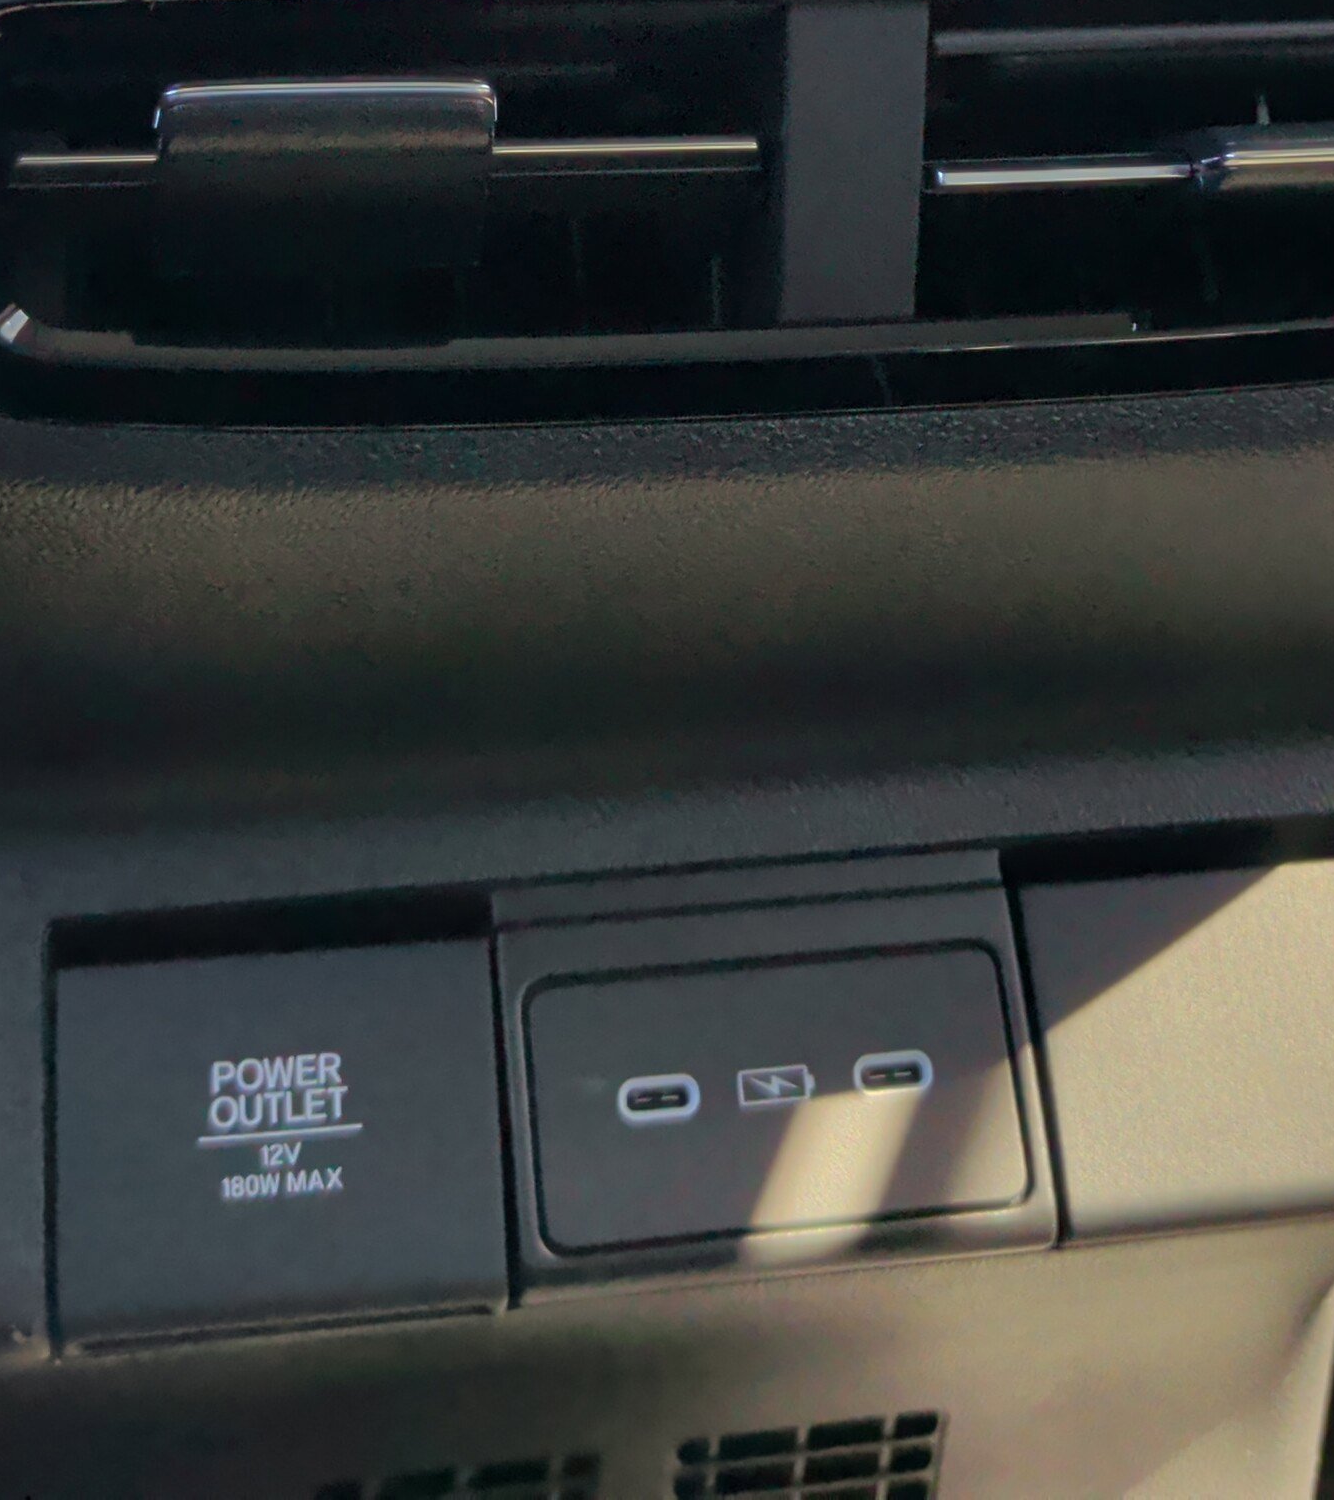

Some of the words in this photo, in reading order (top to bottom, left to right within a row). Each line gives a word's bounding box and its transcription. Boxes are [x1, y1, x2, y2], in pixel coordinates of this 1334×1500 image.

[210, 1052, 342, 1094] POWER
[210, 1086, 348, 1128] OUTLET
[260, 1141, 302, 1166] 12V
[222, 1173, 280, 1198] 180W
[286, 1166, 343, 1192] MAX
